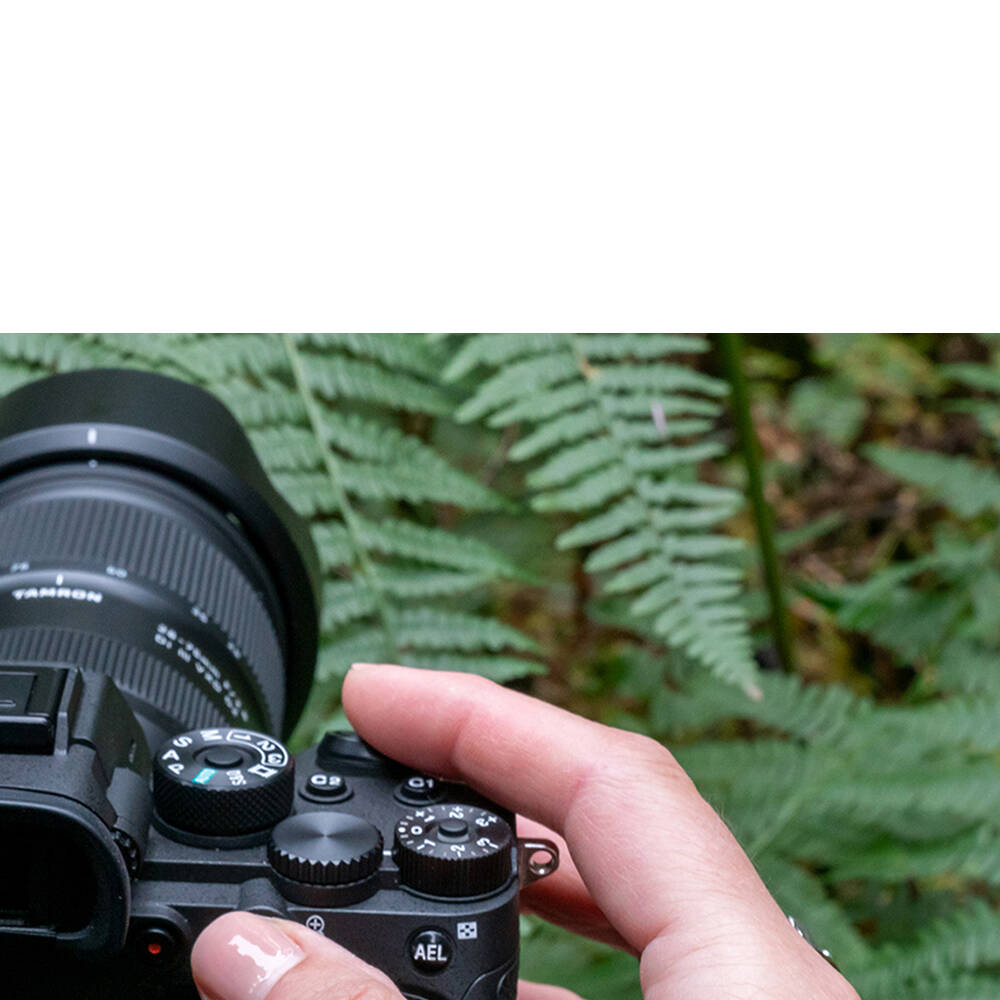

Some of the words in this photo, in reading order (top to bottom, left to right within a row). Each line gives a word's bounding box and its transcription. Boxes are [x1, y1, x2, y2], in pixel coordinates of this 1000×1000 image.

[11, 587, 103, 603] TAMRON
[310, 774, 342, 786] C2
[408, 777, 434, 788] C1
[413, 944, 448, 962] AEL
